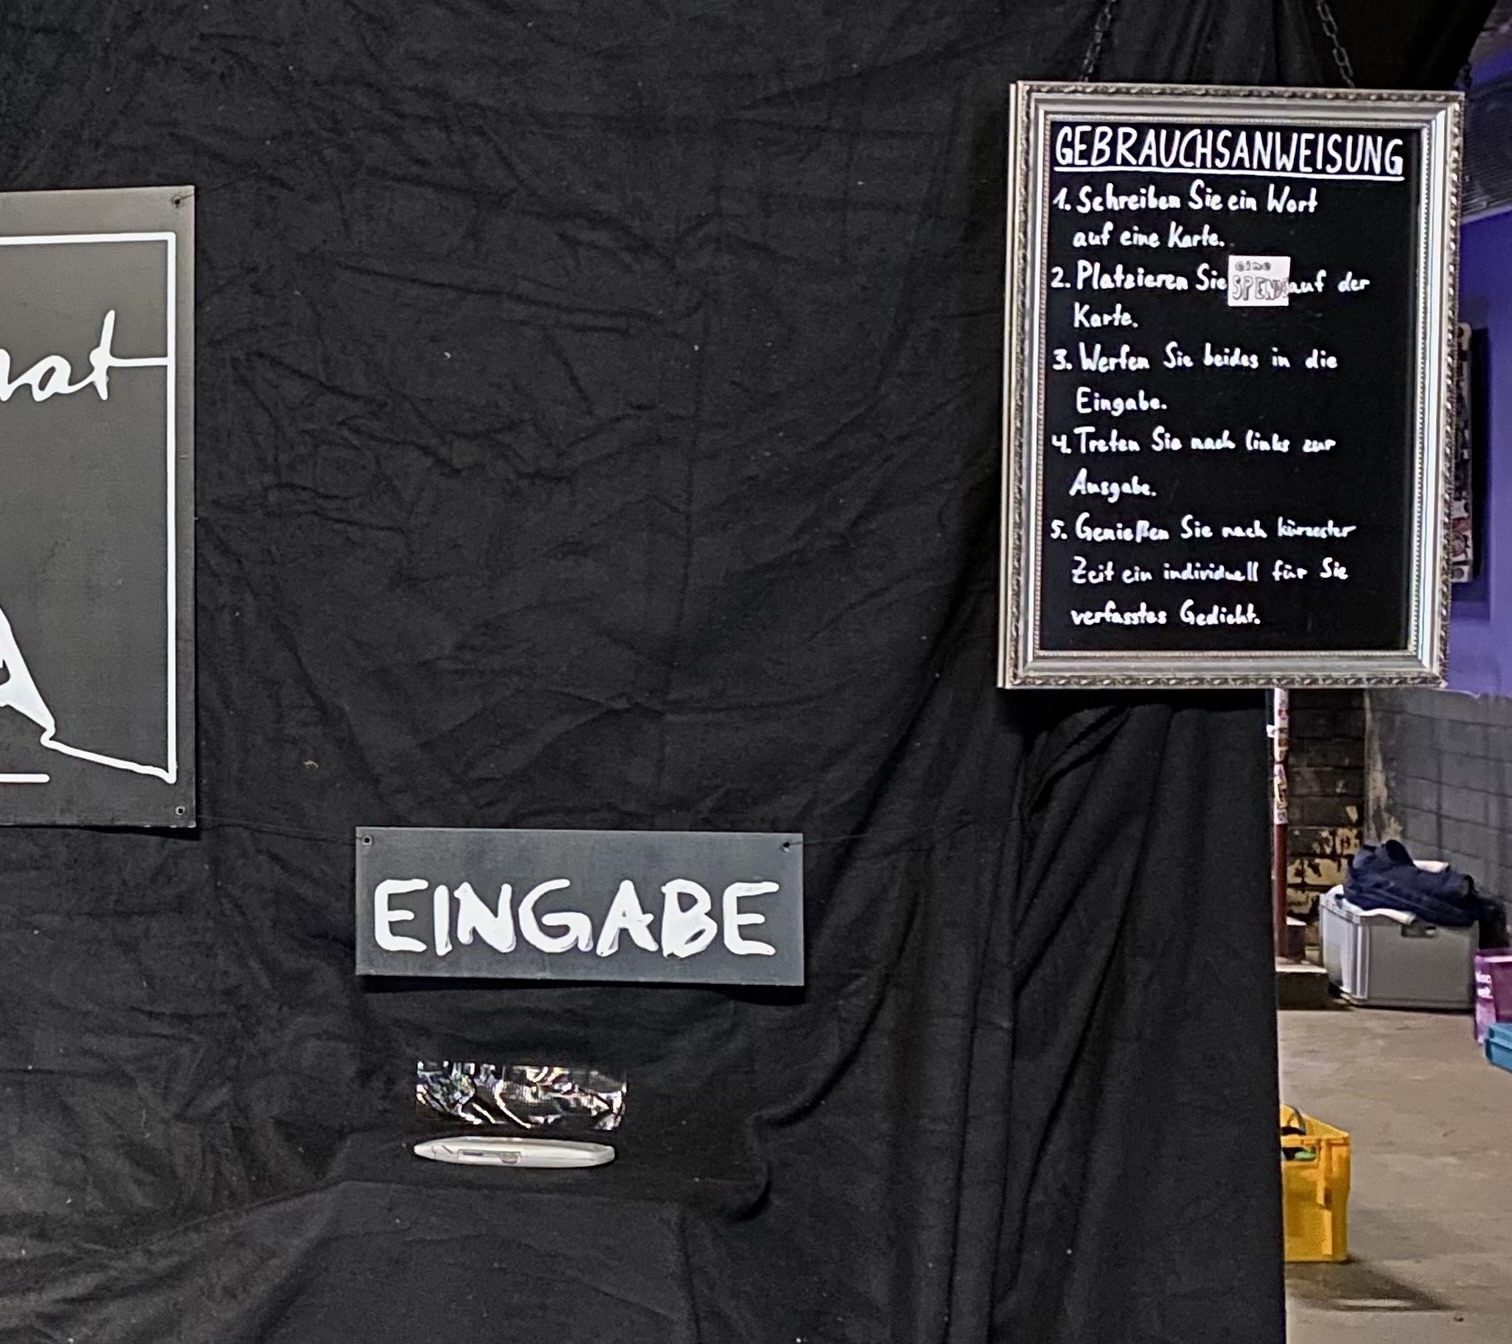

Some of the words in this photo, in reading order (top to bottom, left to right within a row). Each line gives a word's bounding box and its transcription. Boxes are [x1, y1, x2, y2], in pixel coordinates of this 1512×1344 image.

[1055, 125, 1404, 174] GEBRAUCHSANWEISUNG
[1053, 188, 1071, 210] 1.
[1076, 183, 1180, 213] Schreiben
[1188, 179, 1223, 210] Sie
[1228, 190, 1257, 211] ein
[1267, 185, 1317, 213] Wort
[1073, 224, 1113, 247] auf
[1120, 226, 1160, 248] eine
[1168, 221, 1224, 248] Karte.
[1051, 267, 1071, 288] 2.
[1077, 260, 1188, 290] Platzieren
[1196, 262, 1227, 291] Sie
[1288, 269, 1326, 293] auf
[1338, 271, 1370, 292] der
[1074, 302, 1138, 327] Karte.
[1053, 349, 1072, 370] 3.
[1079, 342, 1150, 372] Werfen
[1164, 341, 1193, 368] Sie
[1204, 343, 1258, 368] beides
[1272, 347, 1290, 367] in
[1305, 349, 1337, 368] die
[1077, 387, 1167, 416] Eingabe.
[1052, 435, 1071, 453] 4.
[1074, 426, 1140, 453] Treten
[1152, 426, 1182, 451] Sie
[1191, 433, 1235, 449] nach
[1246, 430, 1290, 452] links
[1069, 468, 1156, 503] Ausgabe.
[1051, 520, 1067, 539] 5.
[1076, 512, 1169, 543] Genießen
[1181, 514, 1213, 538] Sie
[1222, 520, 1267, 538] nach
[1278, 517, 1356, 538] kürzester
[1072, 556, 1114, 583] Zeit
[1122, 566, 1152, 583] ein
[1164, 561, 1258, 581] individuell
[1272, 560, 1307, 581] für
[1320, 557, 1348, 579] Sie
[1071, 601, 1166, 625] verfasstes
[1180, 599, 1260, 626] Gedicht.
[374, 878, 780, 958] EINGABE
